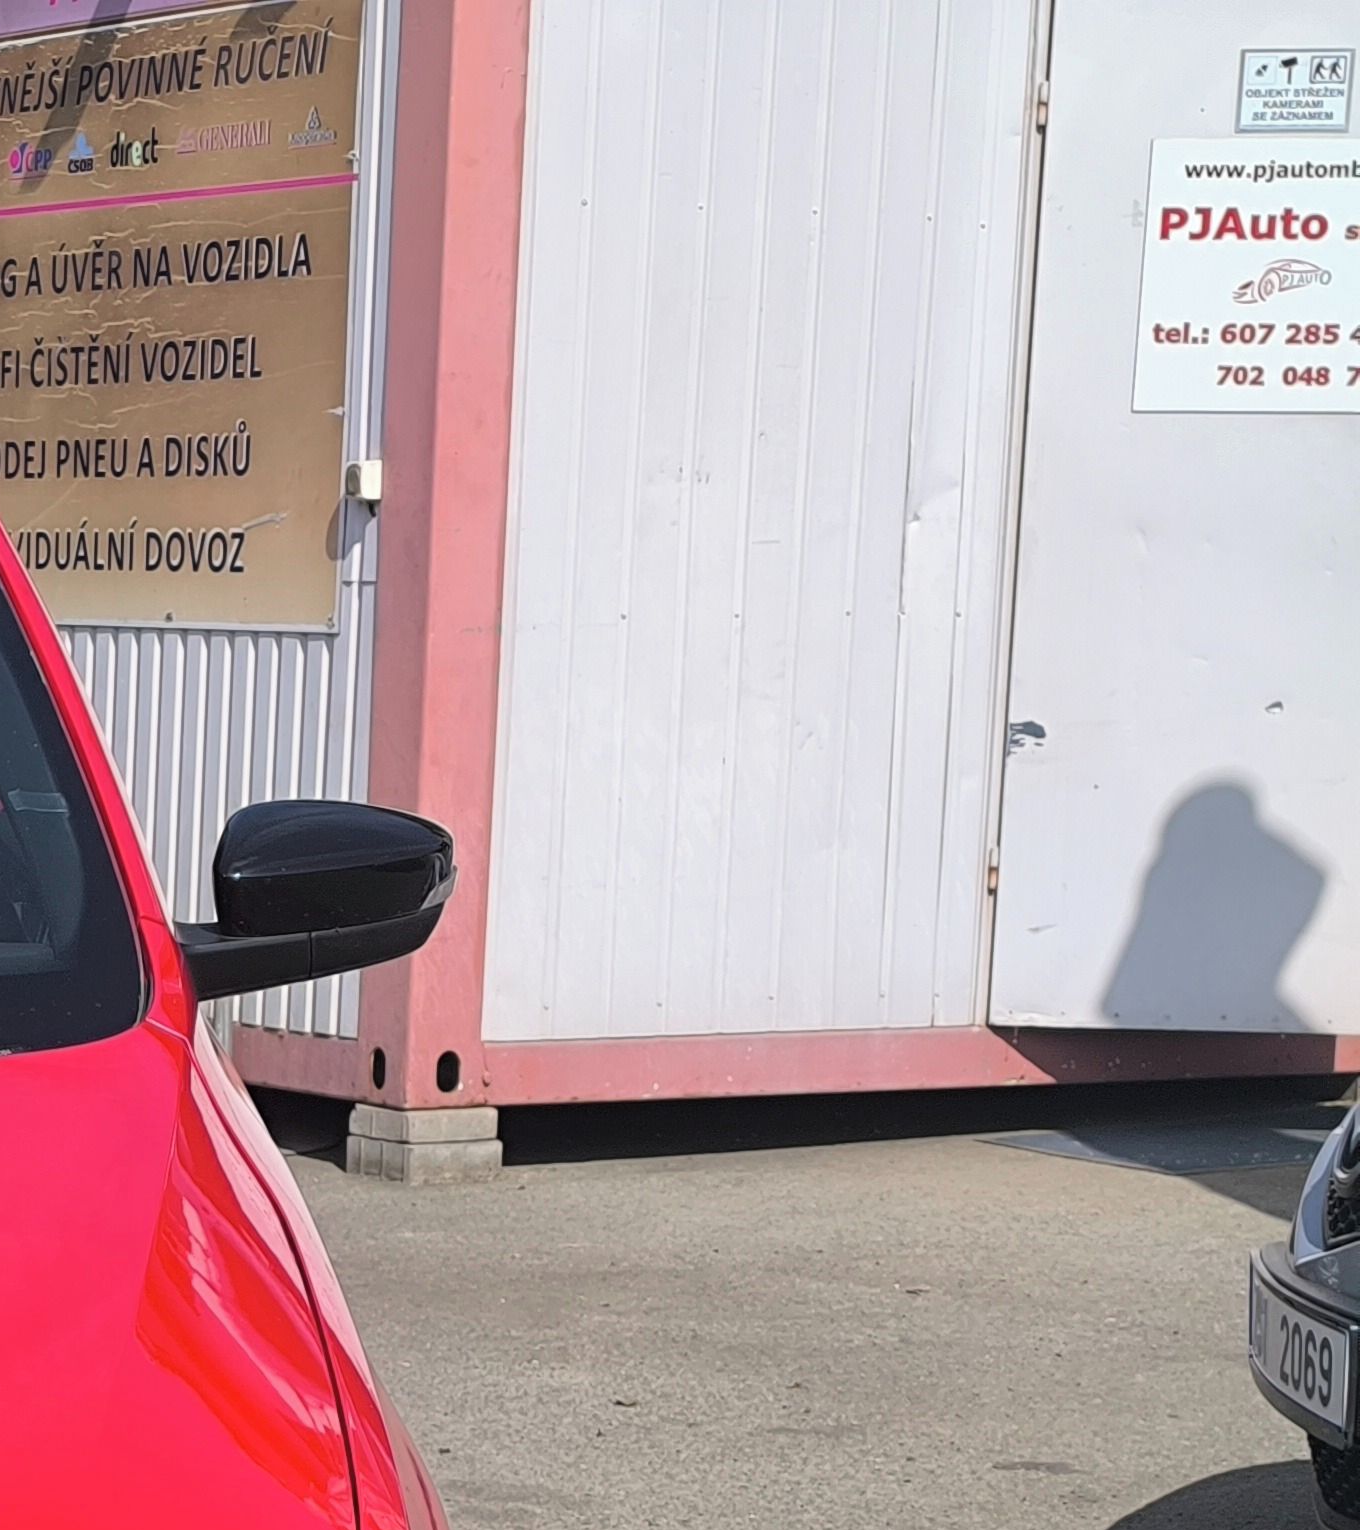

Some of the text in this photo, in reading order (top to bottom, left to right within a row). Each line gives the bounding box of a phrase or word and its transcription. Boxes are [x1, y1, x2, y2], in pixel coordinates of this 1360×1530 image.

[76, 36, 208, 105] POVINNÉ
[213, 17, 334, 87] RUČENÍ
[1245, 86, 1345, 98] OBJEKT STŘEŽEN
[1263, 99, 1324, 109] KAMERAMI
[1252, 110, 1334, 121] SE ZÁZNAMEM
[110, 126, 159, 168] direct
[198, 119, 272, 151] GENERALI
[1159, 206, 1330, 240] PJAuto
[25, 256, 43, 297] A
[51, 239, 122, 294] ÚVĚR
[133, 246, 172, 289] NA
[183, 233, 312, 284] VOZIDLA
[1153, 322, 1210, 345] tel.:
[1220, 323, 1276, 345] 607
[1285, 323, 1341, 345] 285
[30, 331, 134, 388] ČIŠTĚNÍ
[140, 337, 262, 383] VOZIDEL
[1216, 365, 1265, 387] 702
[1282, 366, 1331, 387] 048
[56, 438, 128, 479] PNEU
[136, 437, 155, 478] A
[164, 420, 251, 477] DISKŮ
[145, 530, 245, 573] DOVOZ
[1280, 1314, 1333, 1408] 2069
